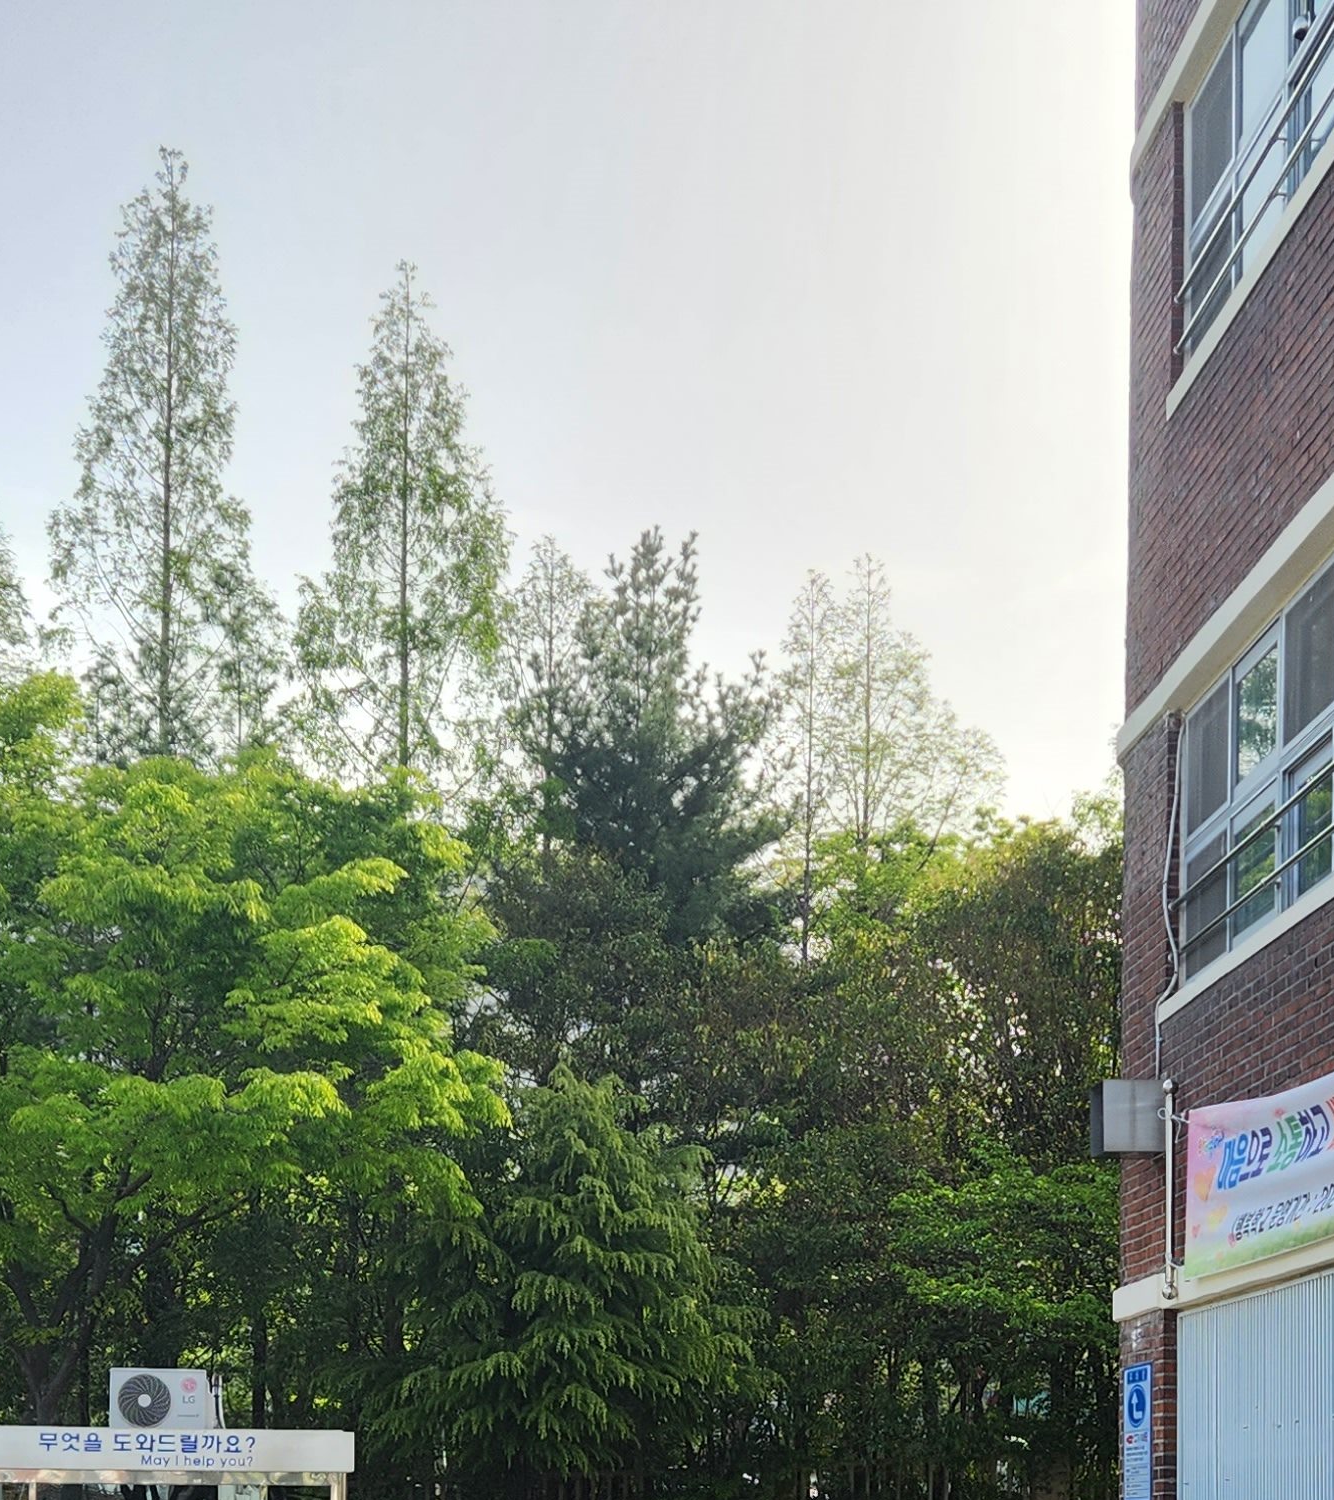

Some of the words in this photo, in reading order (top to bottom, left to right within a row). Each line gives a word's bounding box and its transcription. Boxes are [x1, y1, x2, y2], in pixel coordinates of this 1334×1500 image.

[1266, 1104, 1330, 1173] 소통하고
[182, 1395, 196, 1404] LG
[39, 1432, 102, 1452] 무엇을
[113, 1433, 256, 1454] 도와드릴까요?
[141, 1455, 170, 1468] May
[184, 1455, 215, 1468] help
[220, 1456, 253, 1467] you?
